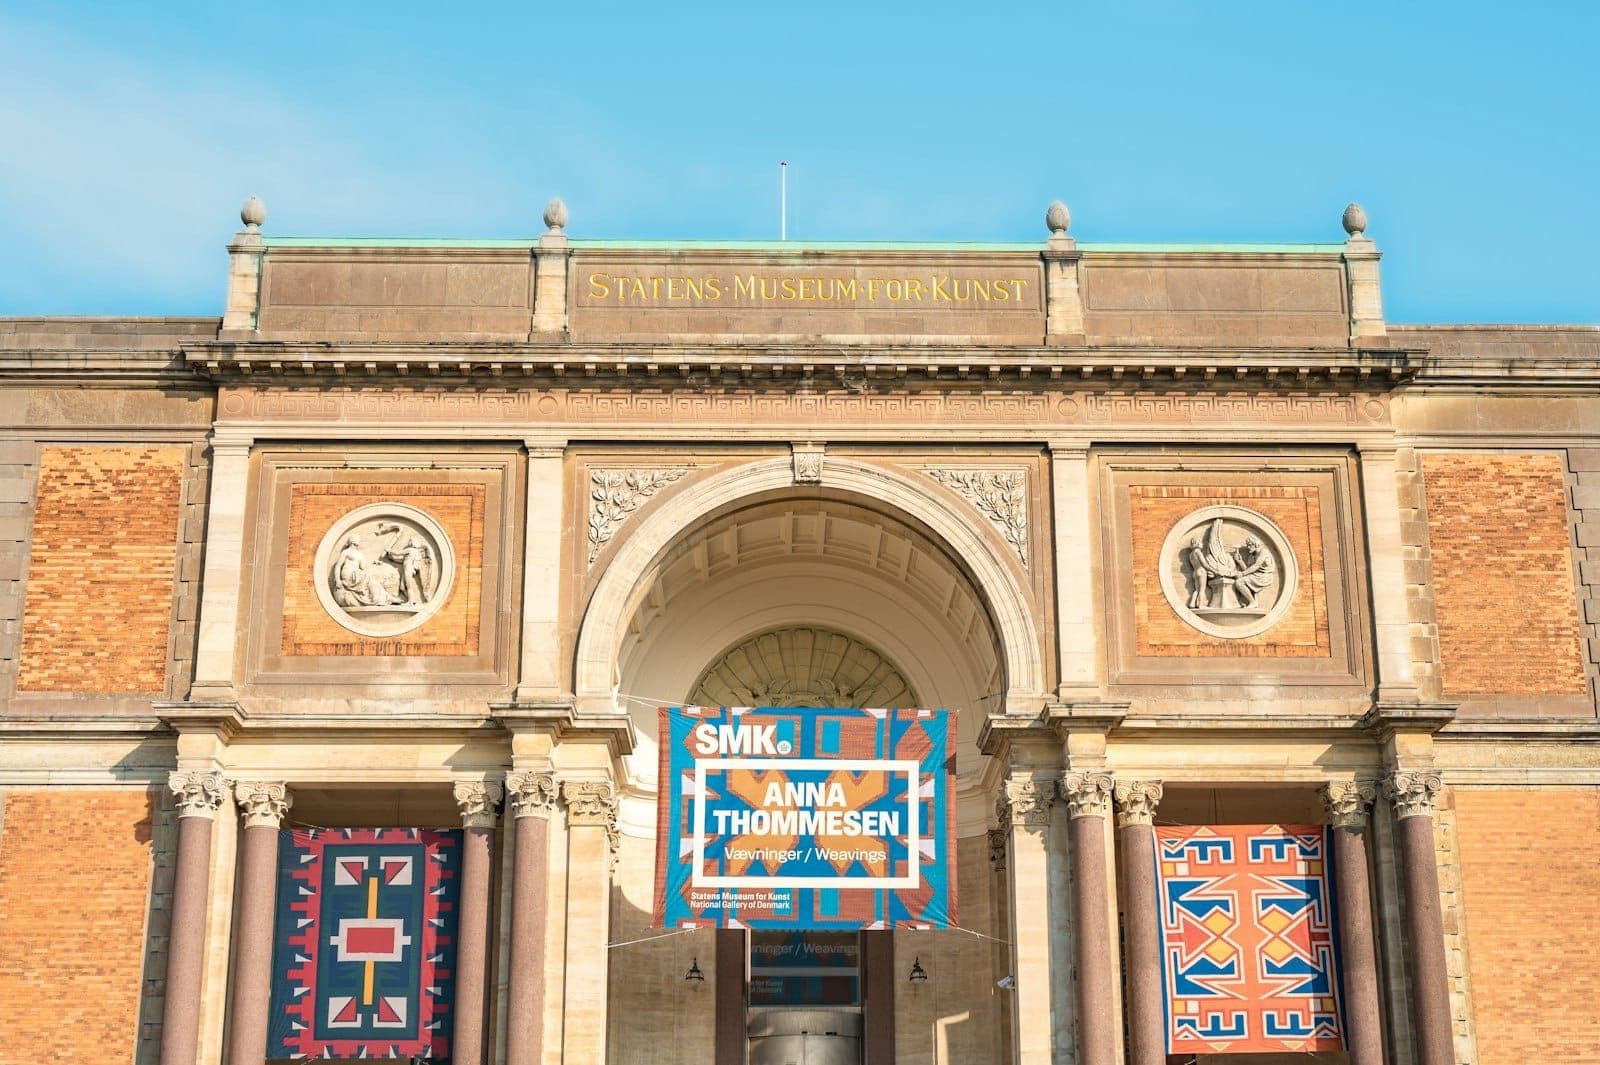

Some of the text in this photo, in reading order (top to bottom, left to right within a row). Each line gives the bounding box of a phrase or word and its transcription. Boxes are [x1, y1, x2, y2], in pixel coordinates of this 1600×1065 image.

[588, 272, 1027, 302] STATENS MUSEUM FOR KUNST
[763, 782, 847, 807] ANNA
[713, 810, 899, 837] THOMMESEN
[725, 847, 887, 864] Vævninger / Weavings
[690, 900, 720, 909] National
[721, 901, 747, 910] Gallery
[757, 901, 790, 909] Denmark
[691, 892, 790, 901] Statens Museum for Kunst
